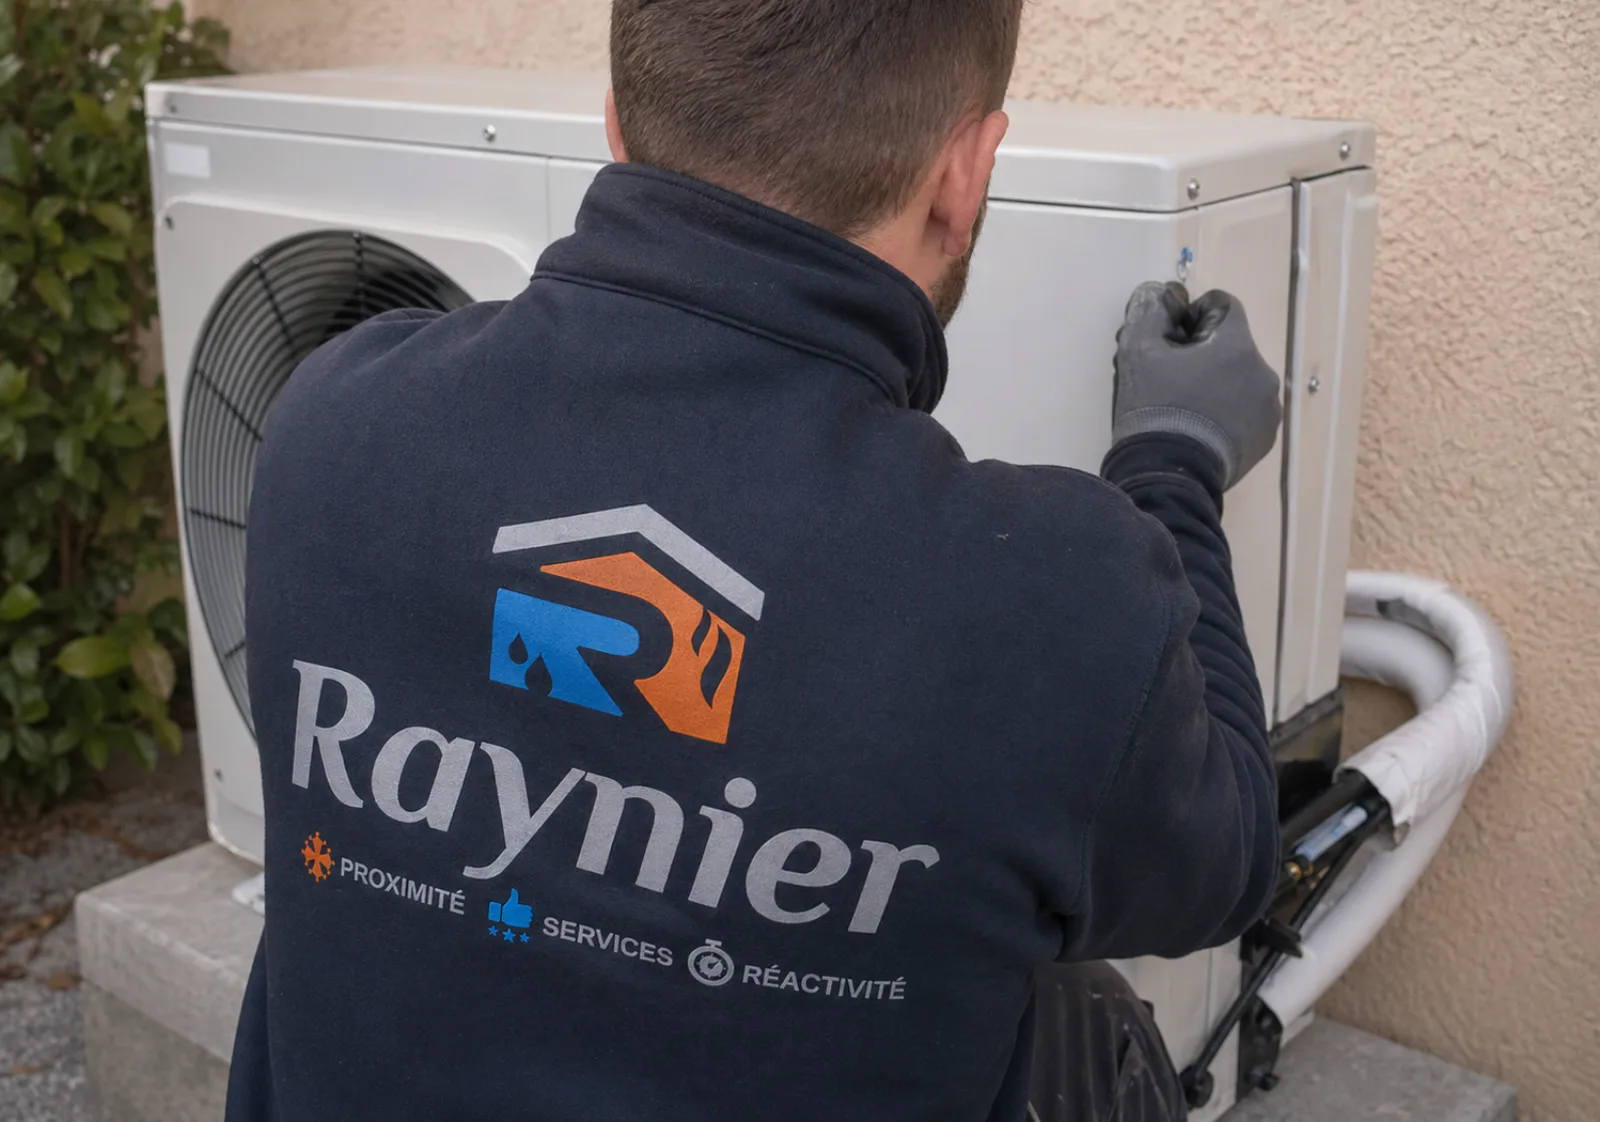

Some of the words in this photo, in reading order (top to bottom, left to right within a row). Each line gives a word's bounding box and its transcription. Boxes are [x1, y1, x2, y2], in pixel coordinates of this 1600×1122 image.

[291, 658, 940, 934] Raynier
[340, 857, 466, 915] PROXIMITÉ
[542, 916, 673, 967] SERVICES
[742, 963, 907, 1000] RÉACTIVITÉ
